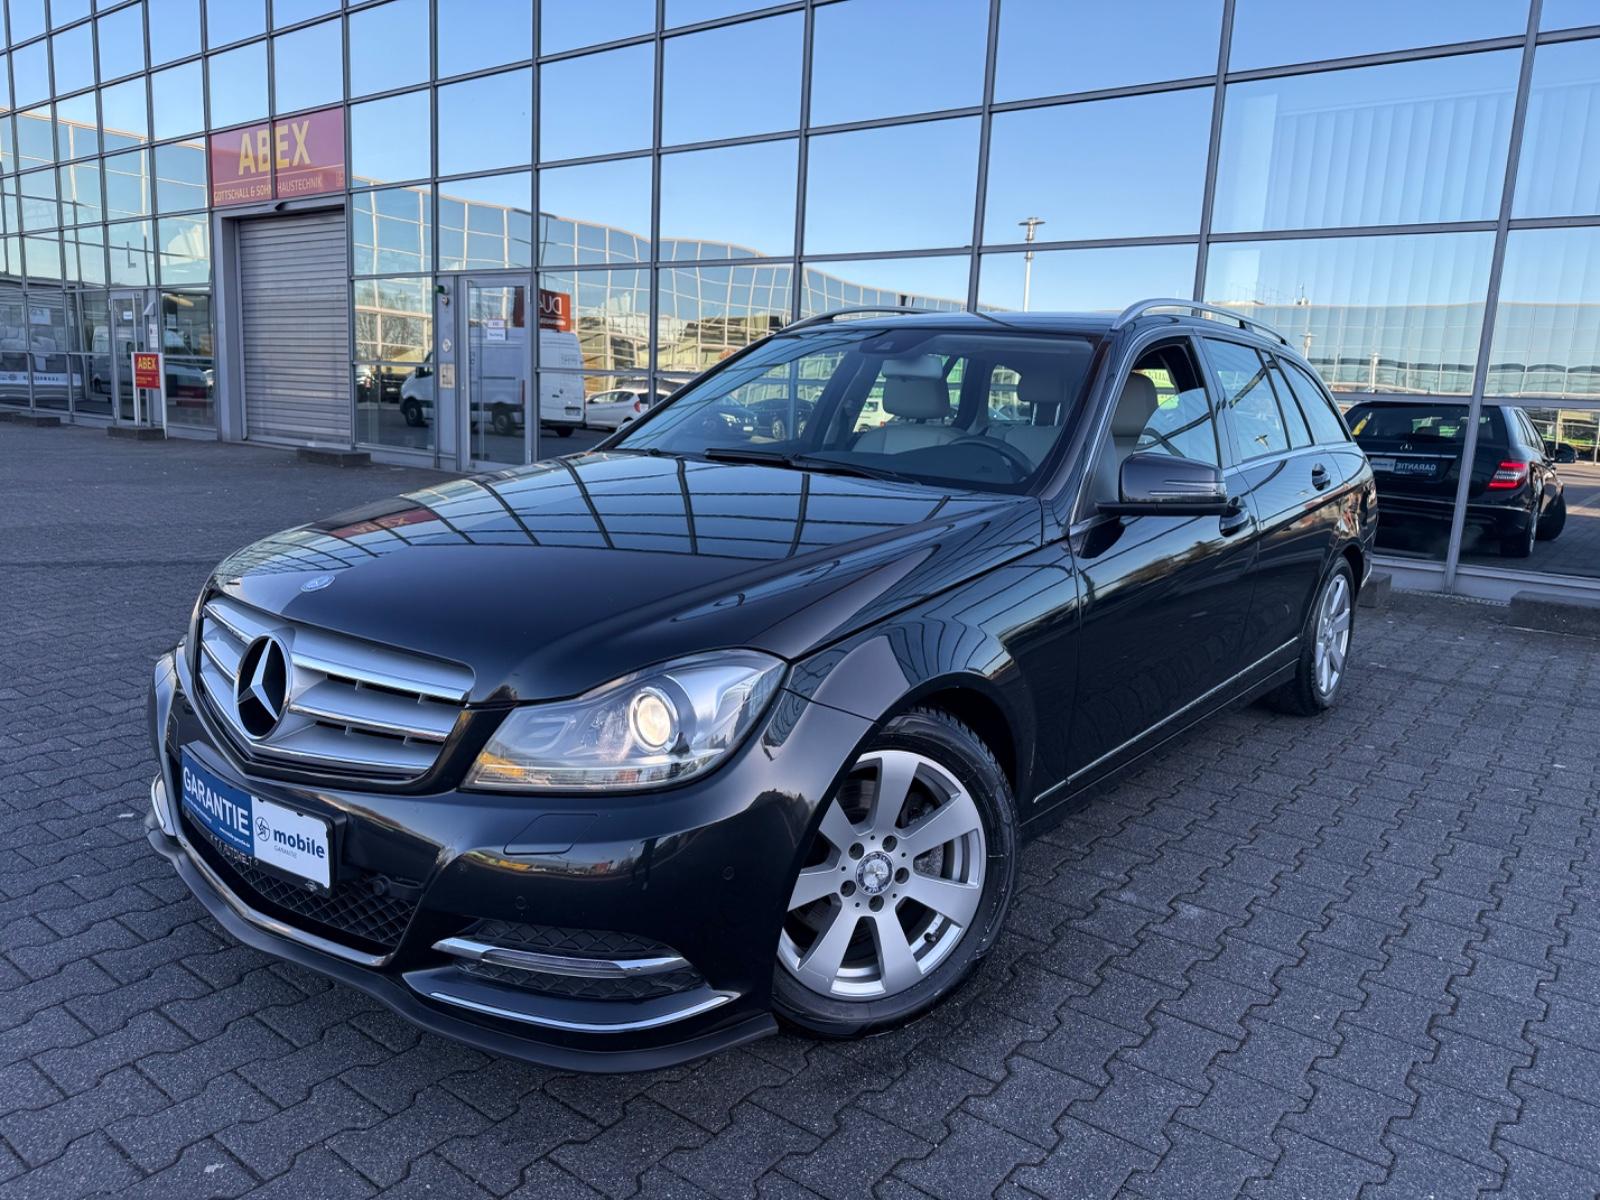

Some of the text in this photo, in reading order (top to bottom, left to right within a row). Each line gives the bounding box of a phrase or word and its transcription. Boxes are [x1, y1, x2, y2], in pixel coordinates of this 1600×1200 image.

[238, 120, 311, 175] ABEX
[137, 356, 157, 370] ABEX
[183, 766, 250, 836] GARANTIE
[273, 828, 325, 859] mobile
